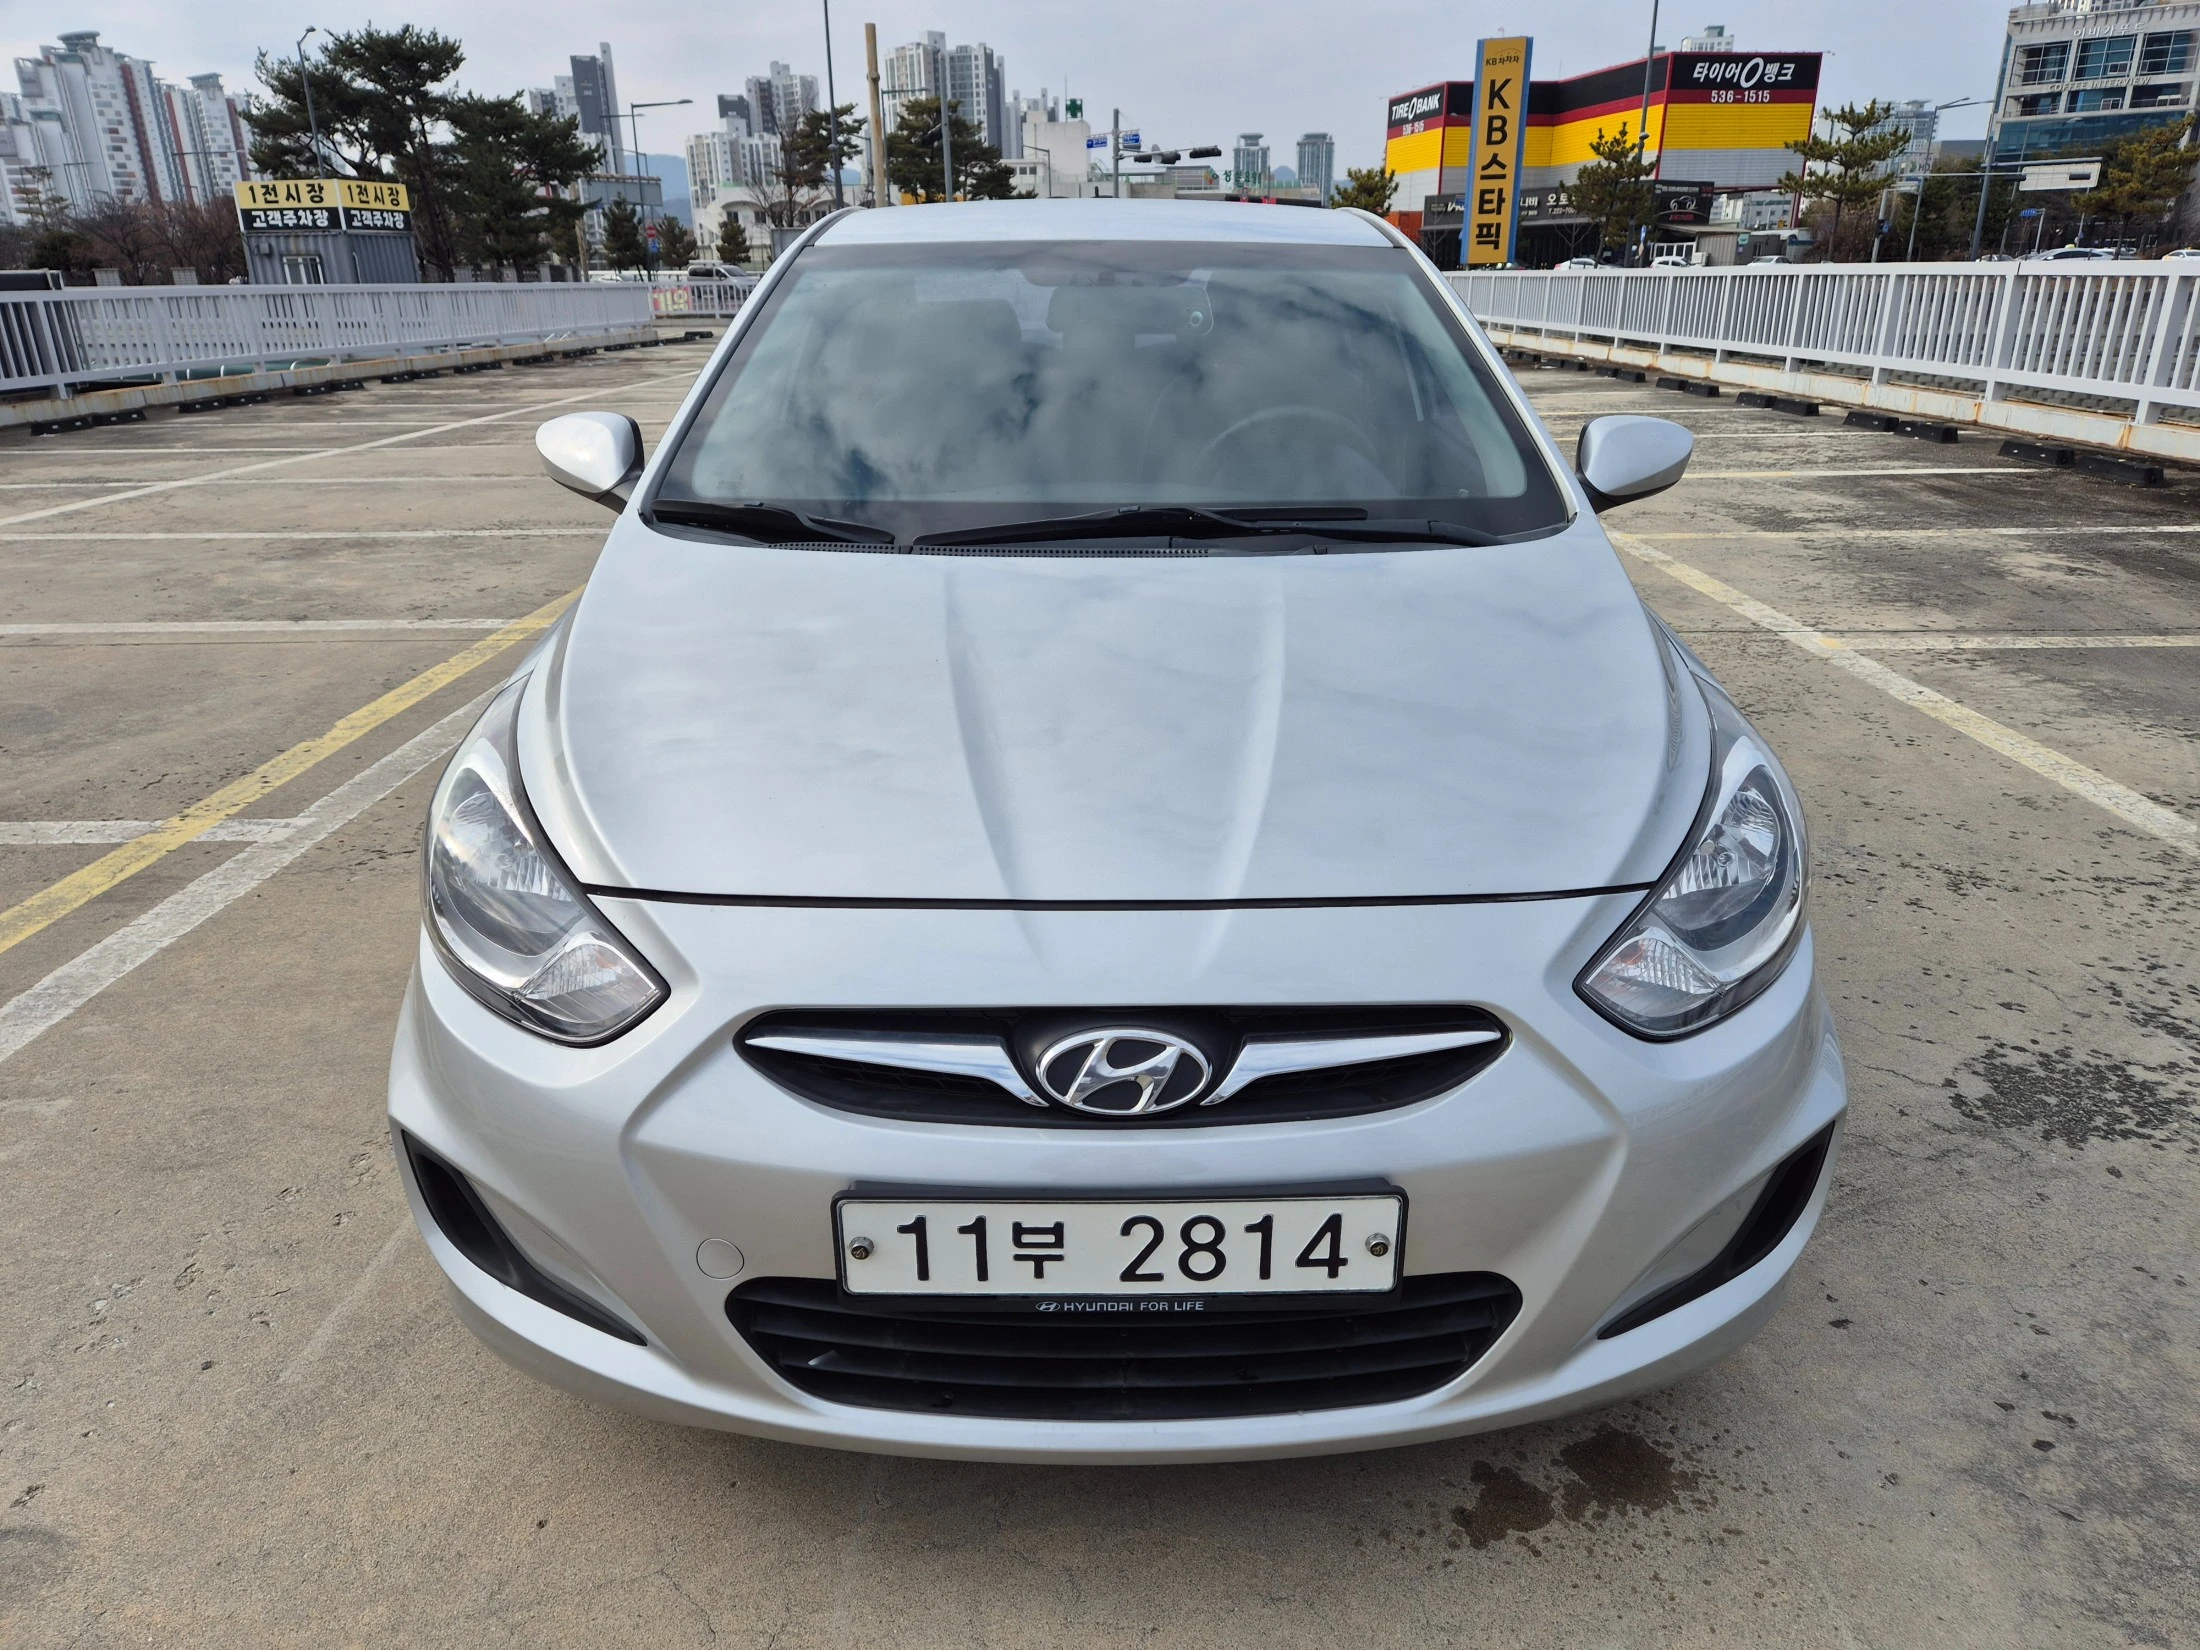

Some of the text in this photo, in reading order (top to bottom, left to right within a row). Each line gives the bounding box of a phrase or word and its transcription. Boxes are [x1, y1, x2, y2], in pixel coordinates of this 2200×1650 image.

[1485, 57, 1498, 66] KB
[2048, 76, 2152, 94] COFFEE INTERVIEW
[1710, 90, 1771, 103] 536-1515
[251, 209, 329, 228] 고객주차장
[351, 210, 405, 229] 고객주차장
[896, 1213, 1349, 1282] 11부 2814
[1063, 1301, 1205, 1312] HYUNDAI FOR LIFE
